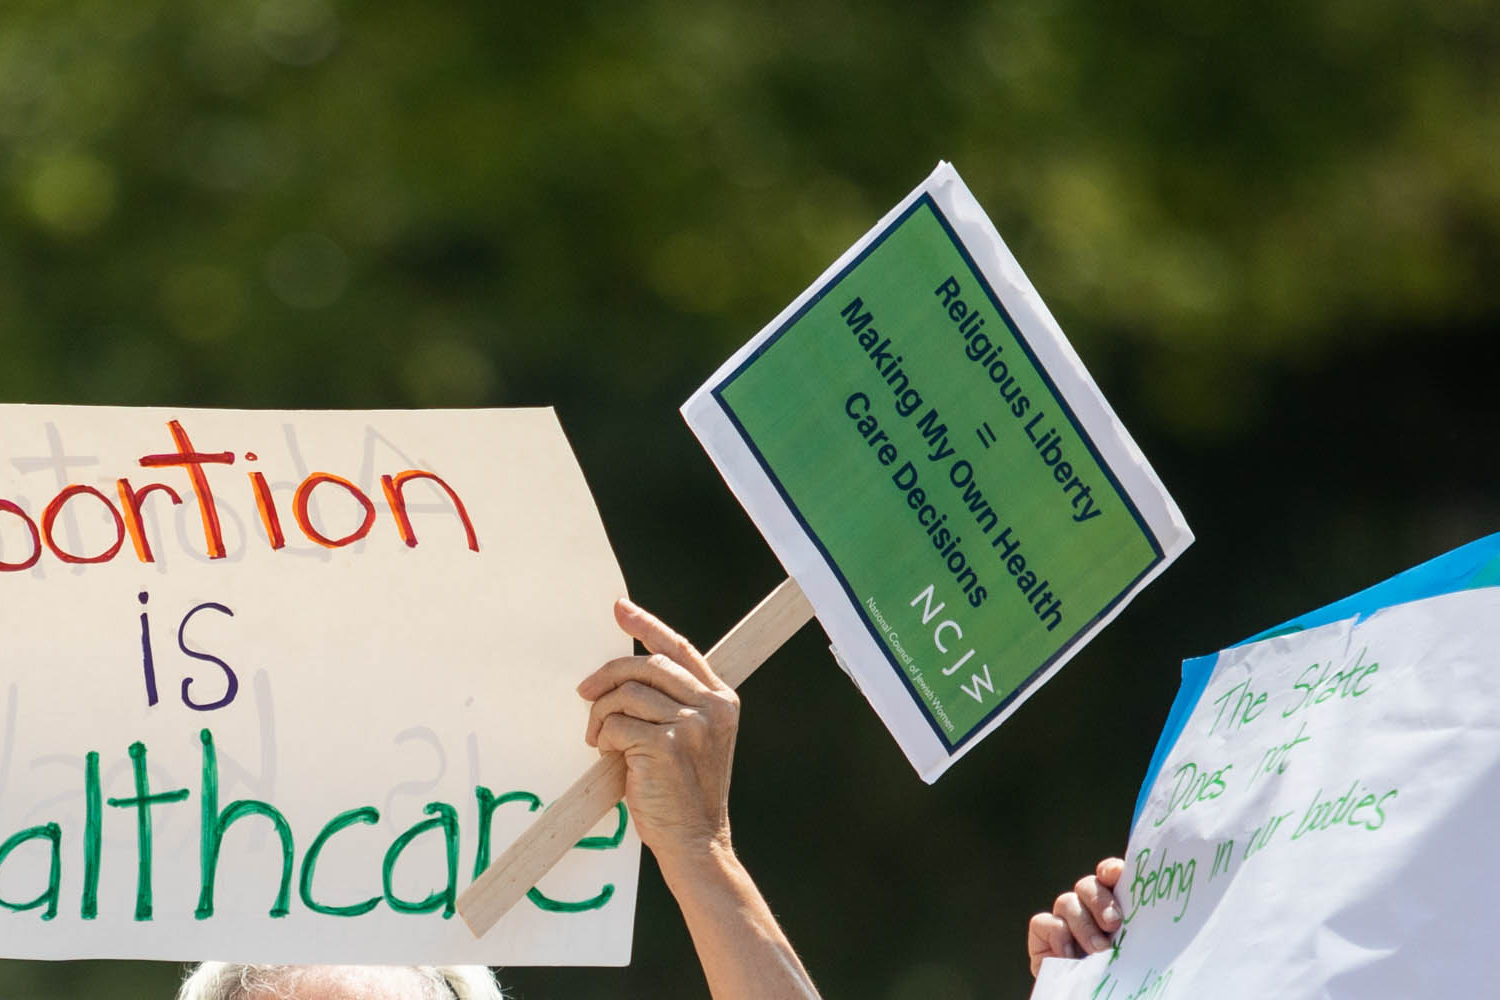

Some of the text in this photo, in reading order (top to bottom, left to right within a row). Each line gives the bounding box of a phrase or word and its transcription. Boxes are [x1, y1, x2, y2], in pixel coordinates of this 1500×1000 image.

[840, 296, 1062, 631] Making My Own Health
[934, 275, 1102, 522] Religious Liberty
[844, 391, 987, 607] Care Decisions
[137, 590, 240, 712] is
[865, 596, 954, 732] National Council of Jewish Women
[909, 583, 1000, 703] NCJW
[1207, 645, 1380, 738] The State
[1153, 720, 1312, 828] Does not
[1122, 847, 1197, 924] Belong
[1208, 838, 1234, 884] in
[1290, 779, 1399, 841] bodies
